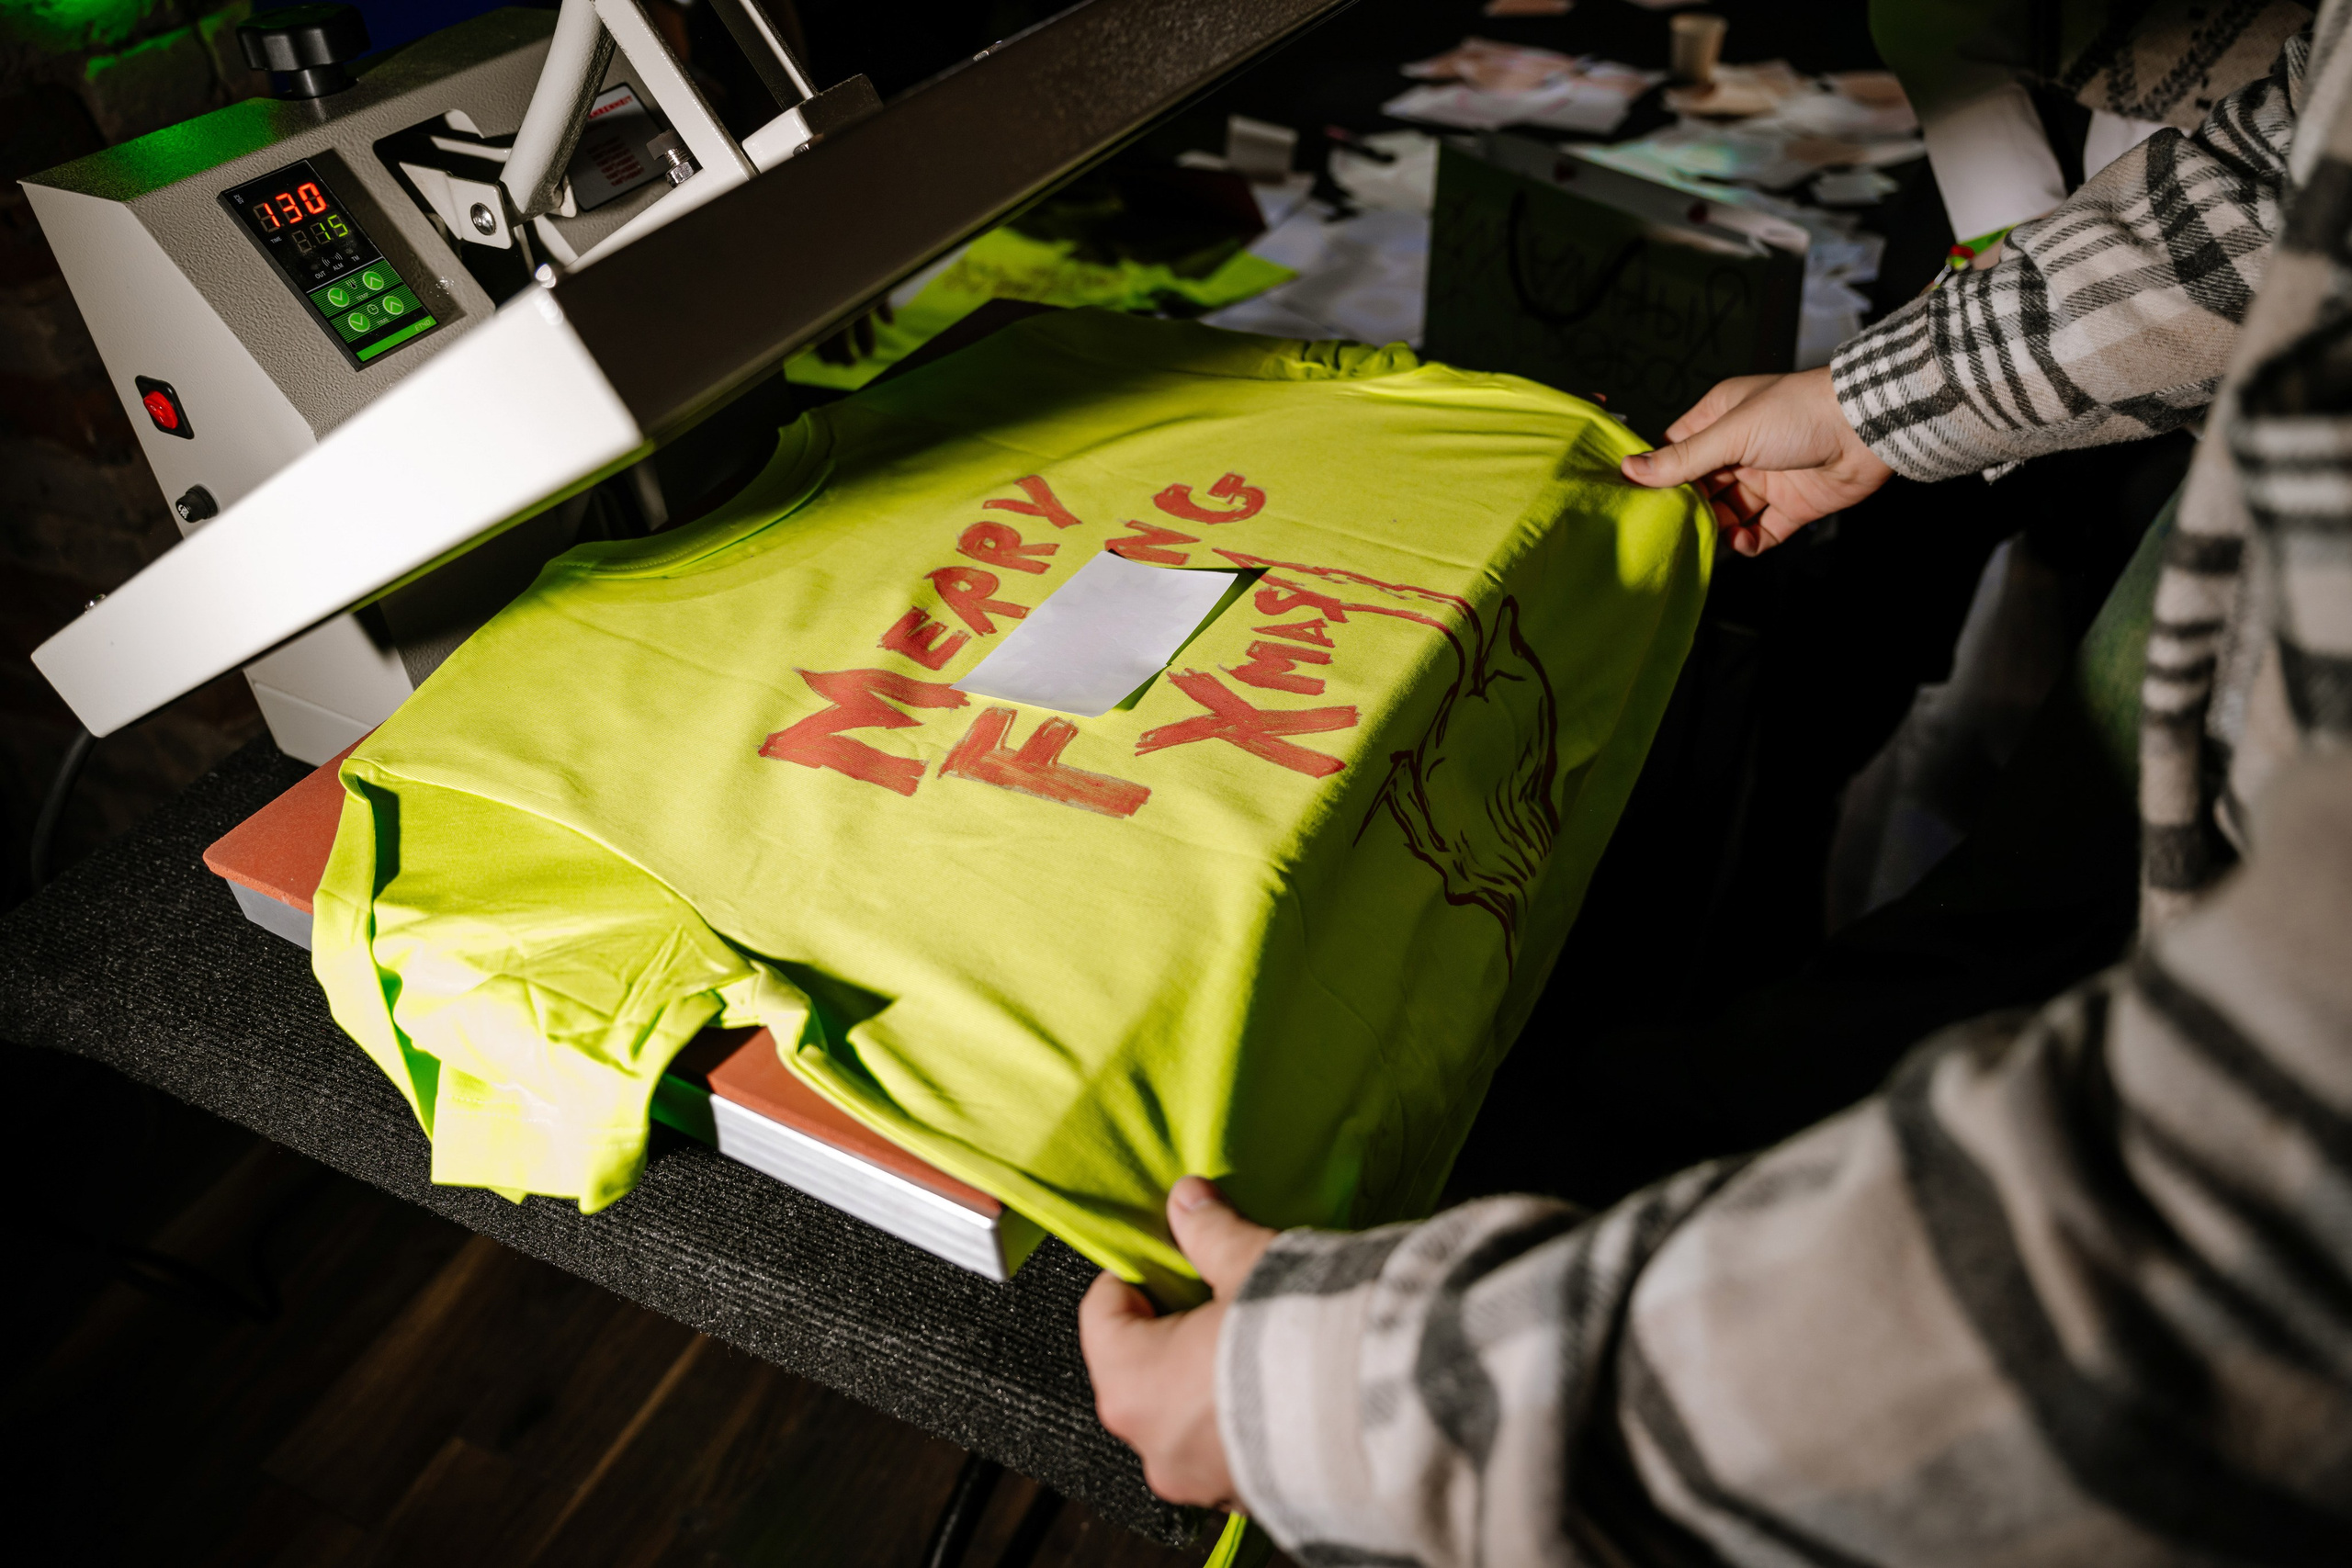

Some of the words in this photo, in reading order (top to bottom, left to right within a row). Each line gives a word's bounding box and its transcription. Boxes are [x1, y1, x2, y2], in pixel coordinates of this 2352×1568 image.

[588, 95, 633, 120] AHRENHEIT
[264, 182, 328, 229] 130
[270, 236, 282, 244] TIME
[319, 213, 349, 241] 15
[314, 270, 326, 279] OUT
[333, 262, 344, 271] ALM
[758, 473, 1083, 797] MERRY
